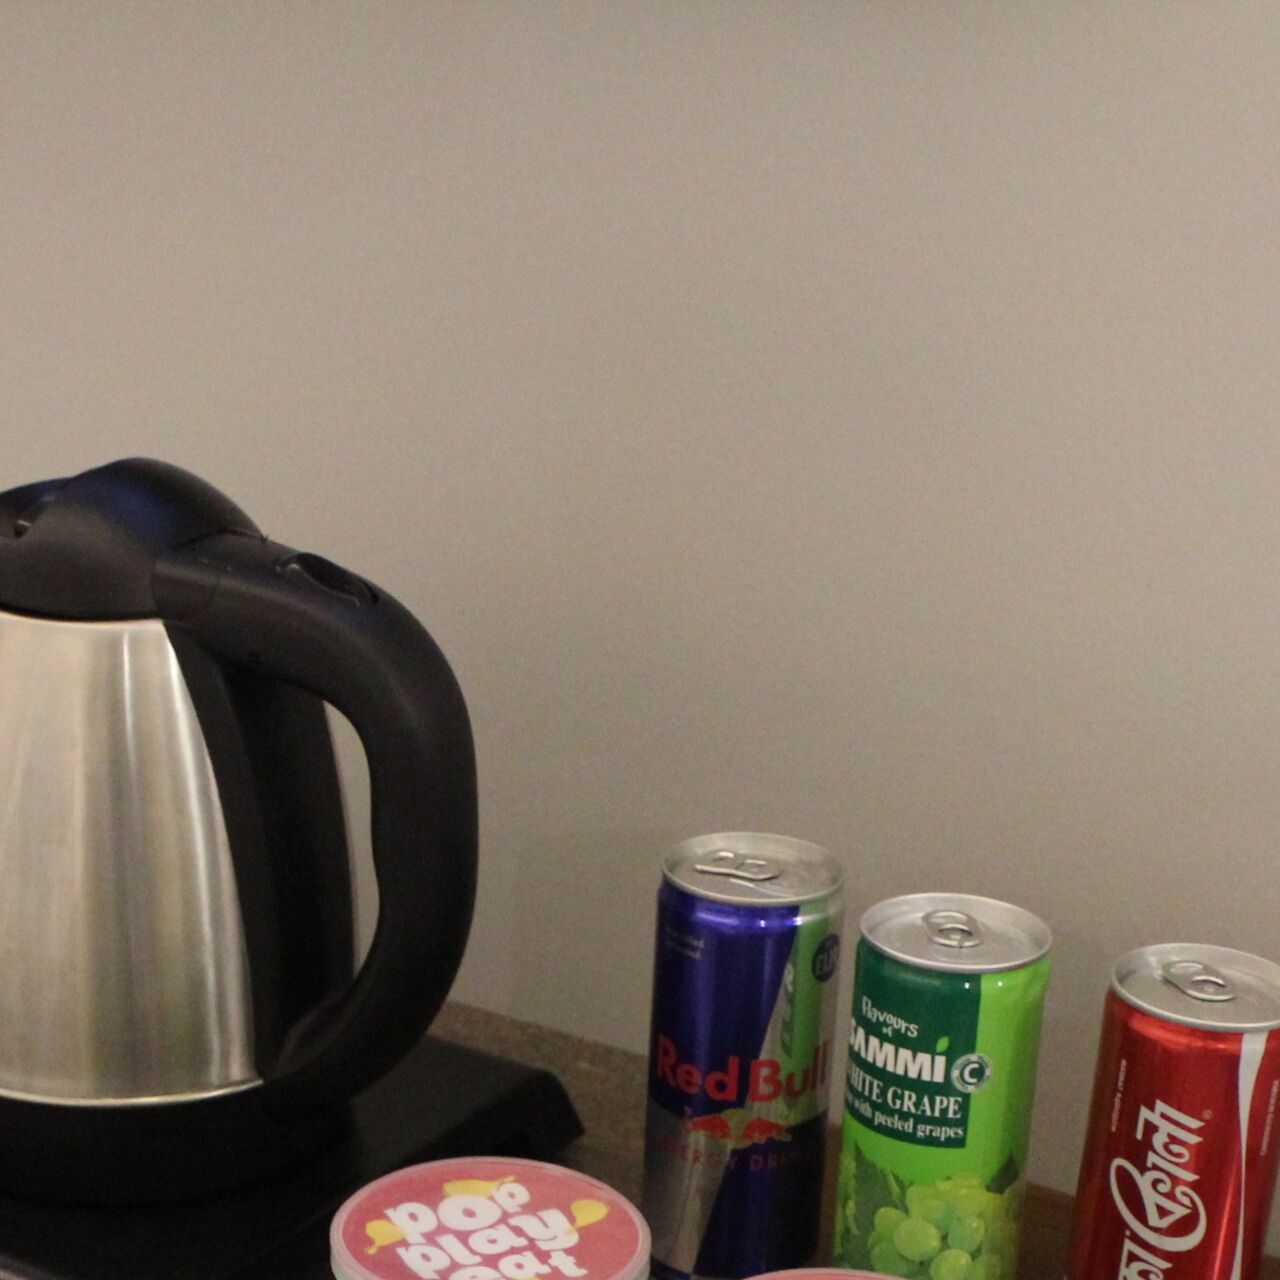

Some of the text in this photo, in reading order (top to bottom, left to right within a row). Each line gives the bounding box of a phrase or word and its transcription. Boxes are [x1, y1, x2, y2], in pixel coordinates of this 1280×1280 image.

[862, 996, 919, 1038] Flavours
[658, 1035, 740, 1102] Red
[887, 1086, 963, 1118] GRAPE
[874, 1110, 914, 1133] peeled
[917, 1122, 965, 1141] grapes
[395, 1208, 580, 1280] play
